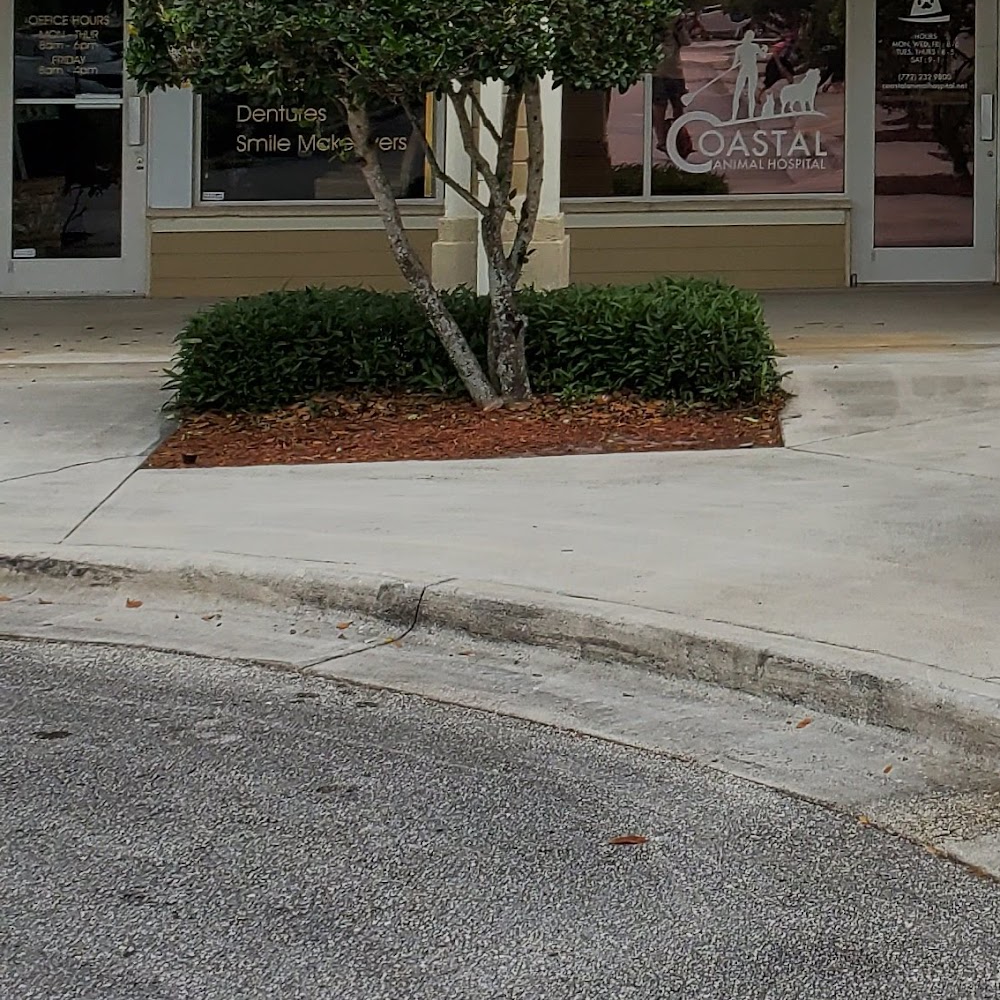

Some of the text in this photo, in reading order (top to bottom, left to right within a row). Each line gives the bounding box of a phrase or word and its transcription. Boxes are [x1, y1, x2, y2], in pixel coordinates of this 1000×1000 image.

[28, 14, 110, 26] OFFICE HOURS
[52, 55, 86, 65] FRIDAY
[236, 104, 327, 122] Dentures
[236, 134, 291, 152] Smile
[666, 111, 827, 173] COASTAL
[713, 158, 826, 170] ANIMAL HOSPITAL
